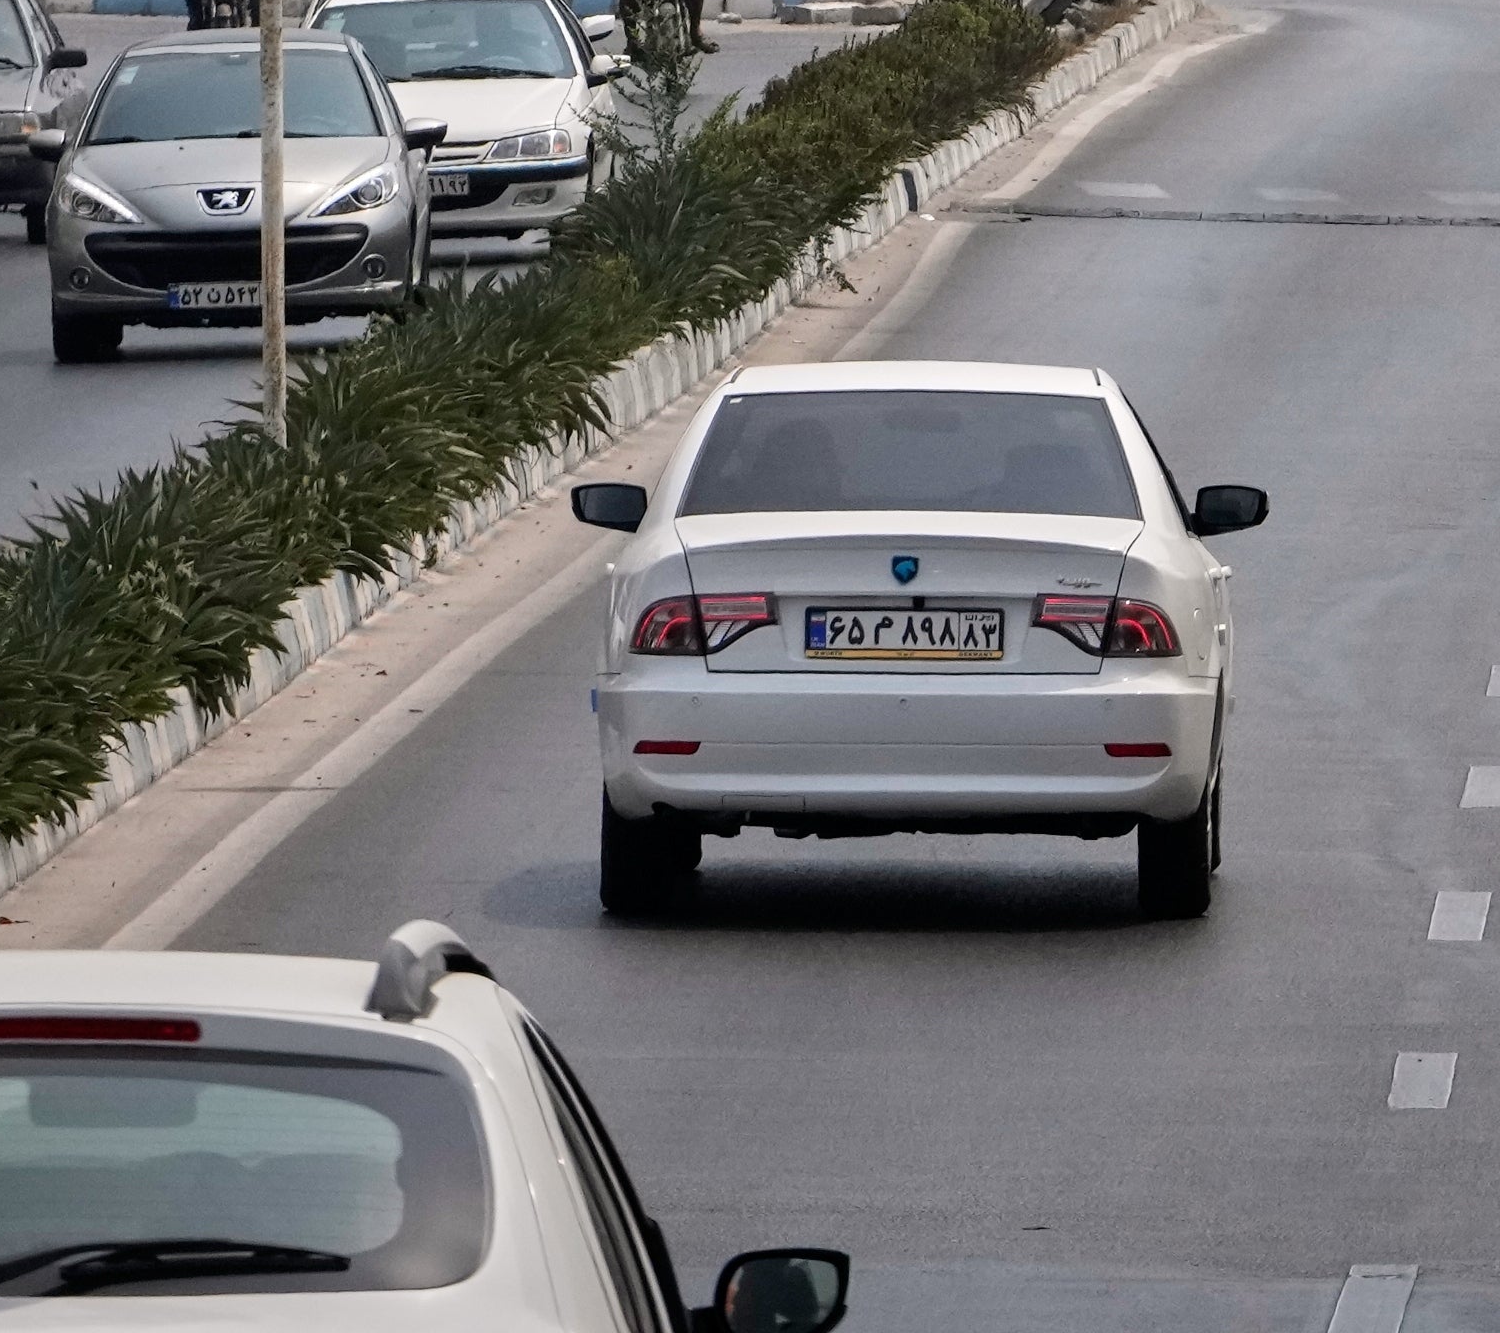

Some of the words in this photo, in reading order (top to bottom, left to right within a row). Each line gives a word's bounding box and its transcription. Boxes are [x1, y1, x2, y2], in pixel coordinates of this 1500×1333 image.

[829, 616, 865, 646] ۶۵
[874, 615, 894, 645] م
[902, 615, 956, 646] ۸۹۸
[963, 623, 998, 649] ۸۳
